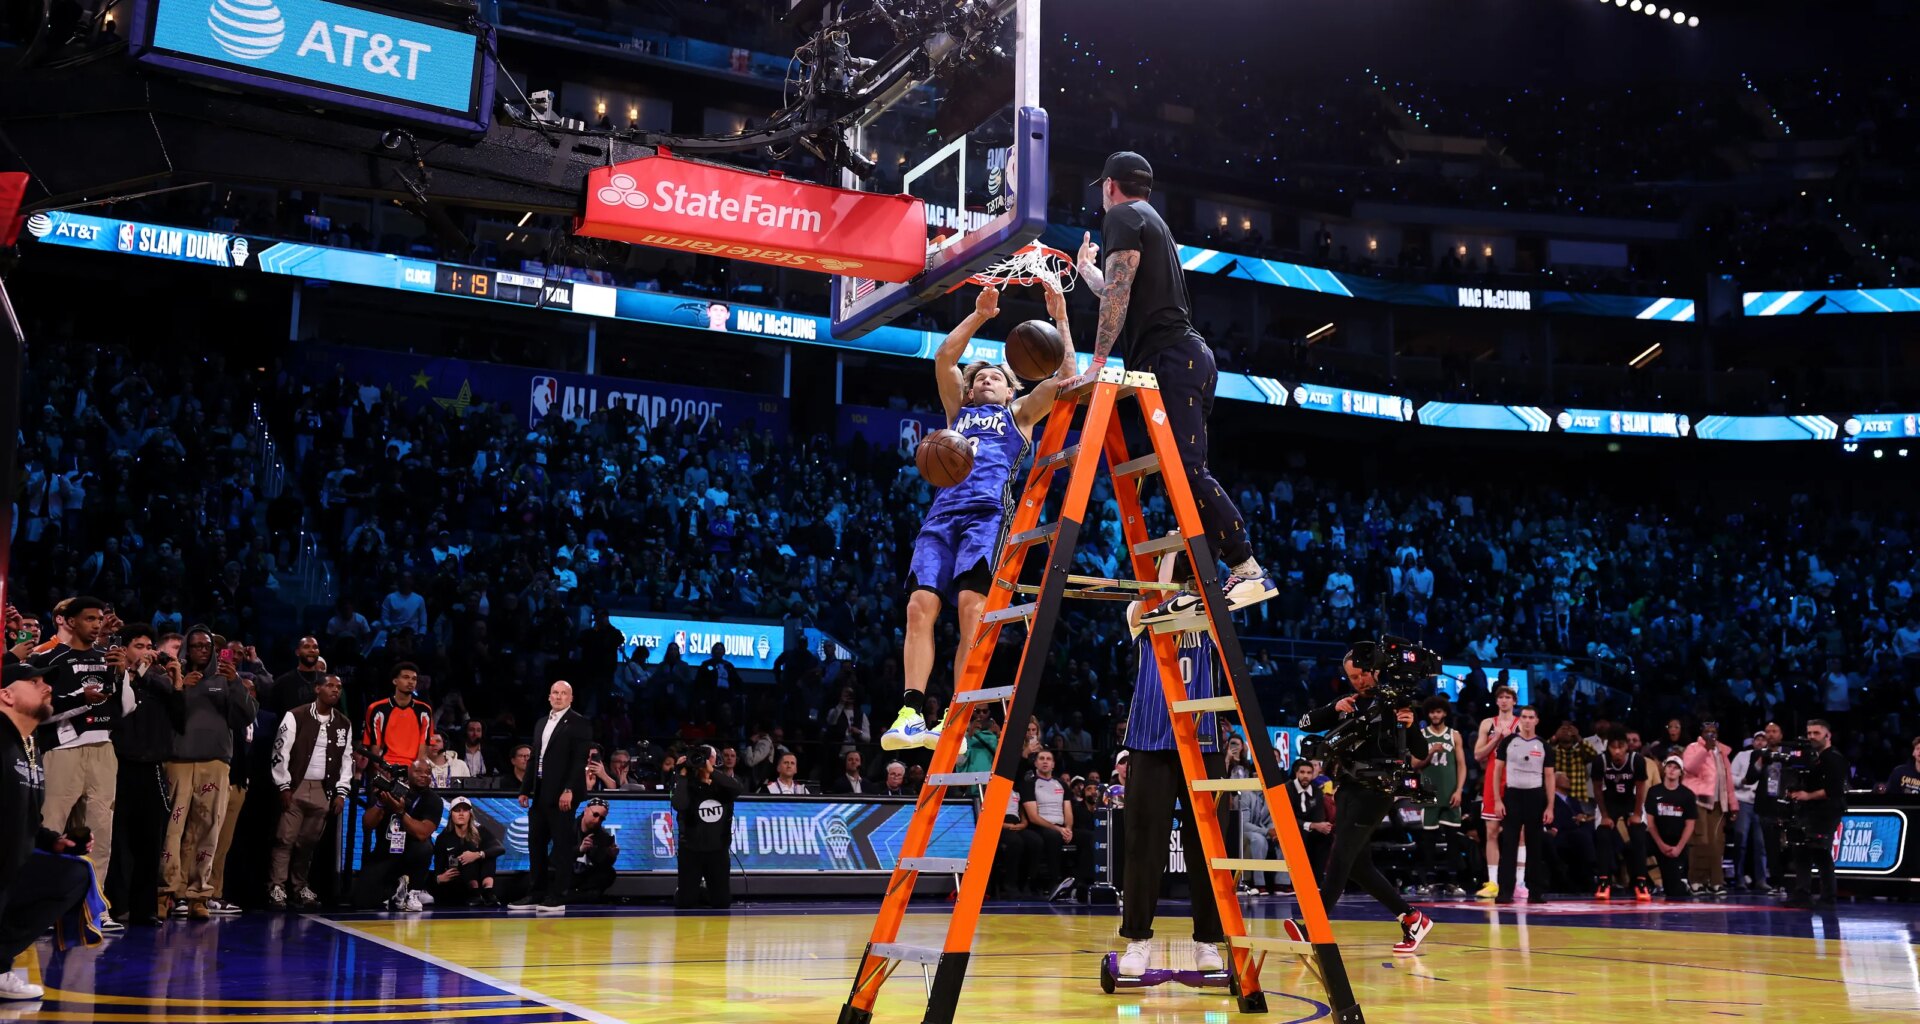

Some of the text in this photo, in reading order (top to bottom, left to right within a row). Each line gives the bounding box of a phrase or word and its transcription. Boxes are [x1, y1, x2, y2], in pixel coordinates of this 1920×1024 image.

[296, 20, 431, 81] AT&T
[56, 222, 102, 240] AT&T
[138, 227, 229, 263] SLAM DUNK
[1458, 287, 1531, 311] MAC McCLUNG
[737, 309, 816, 341] MAC McCLUNG
[975, 347, 998, 359] AT&T
[1309, 391, 1334, 405] AT&T
[1353, 394, 1377, 414] SLAM
[1573, 415, 1600, 428] AT&T
[1622, 414, 1649, 433] SLAM
[1863, 420, 1893, 432] AT&T
[629, 634, 662, 648] AT&T
[724, 635, 755, 656] DUNK
[1431, 752, 1448, 766] 44
[698, 806, 724, 816] TNT
[758, 816, 820, 855] DUNK
[1169, 829, 1184, 852] SL
[1843, 829, 1872, 846] SLAM
[1840, 845, 1870, 863] DUNK
